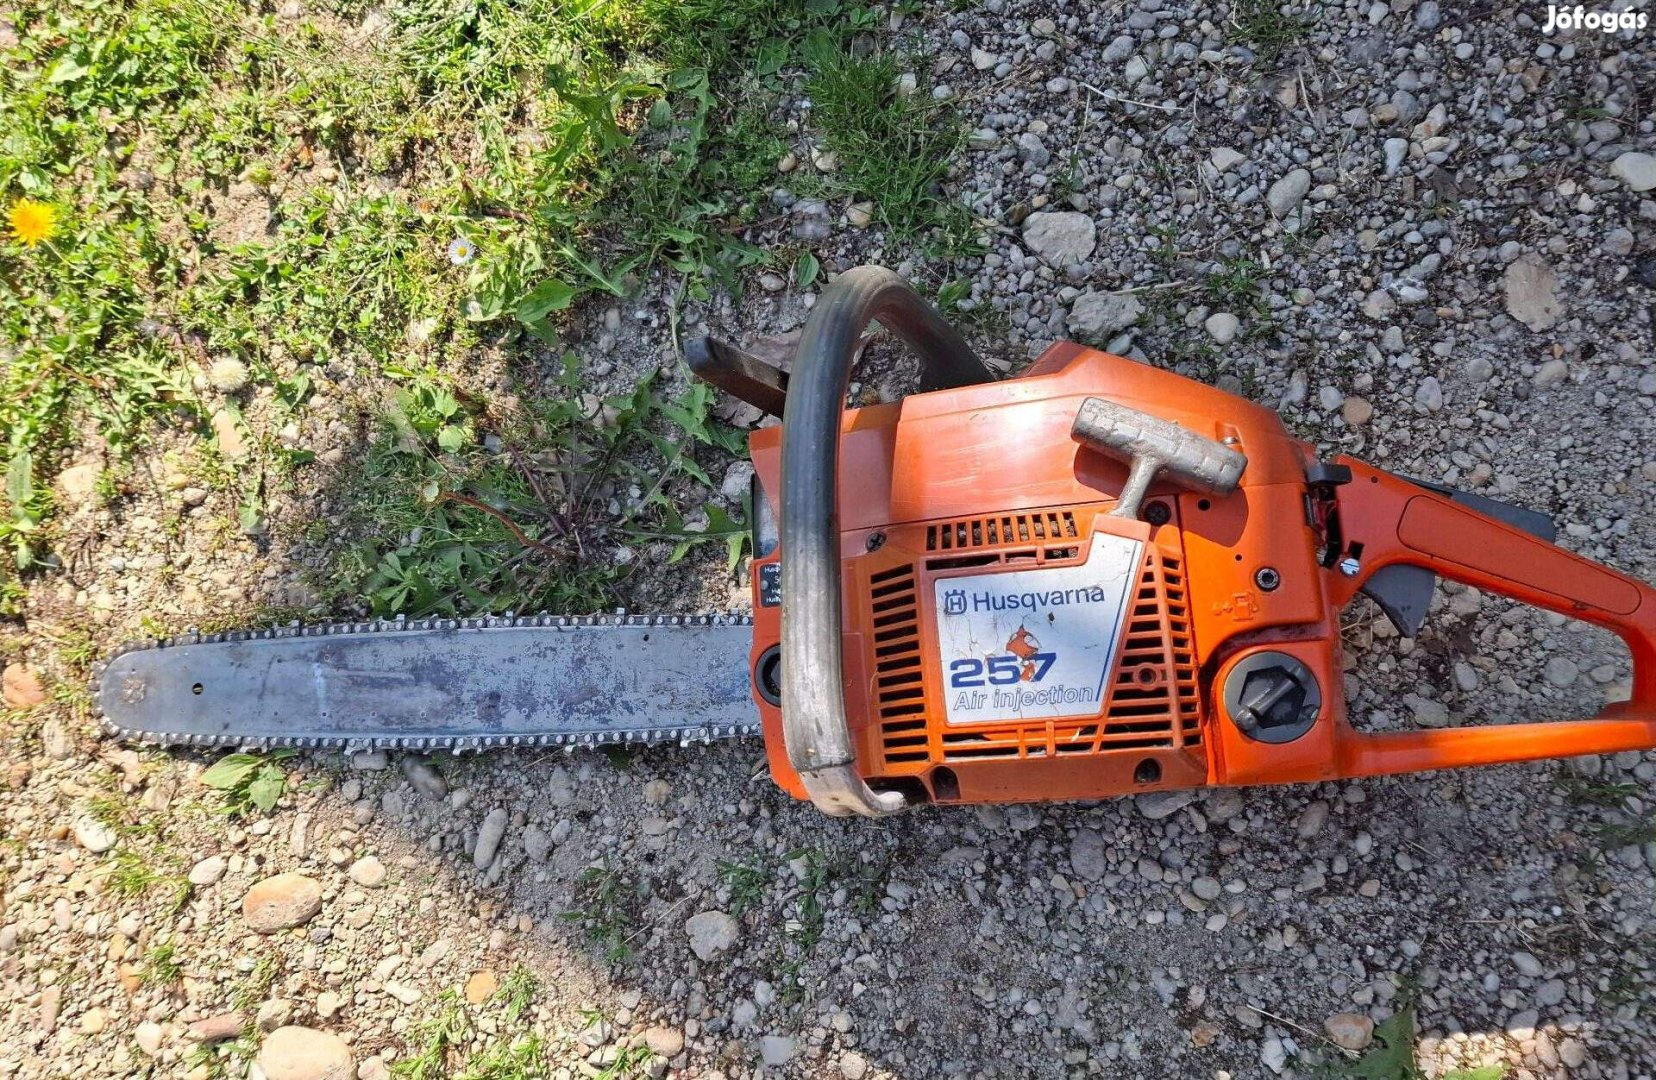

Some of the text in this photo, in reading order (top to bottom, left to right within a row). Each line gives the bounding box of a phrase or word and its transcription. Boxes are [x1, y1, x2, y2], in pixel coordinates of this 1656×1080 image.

[973, 585, 1105, 612] Husqvarna
[950, 653, 1057, 688] 257
[953, 684, 1094, 712] Air injection
